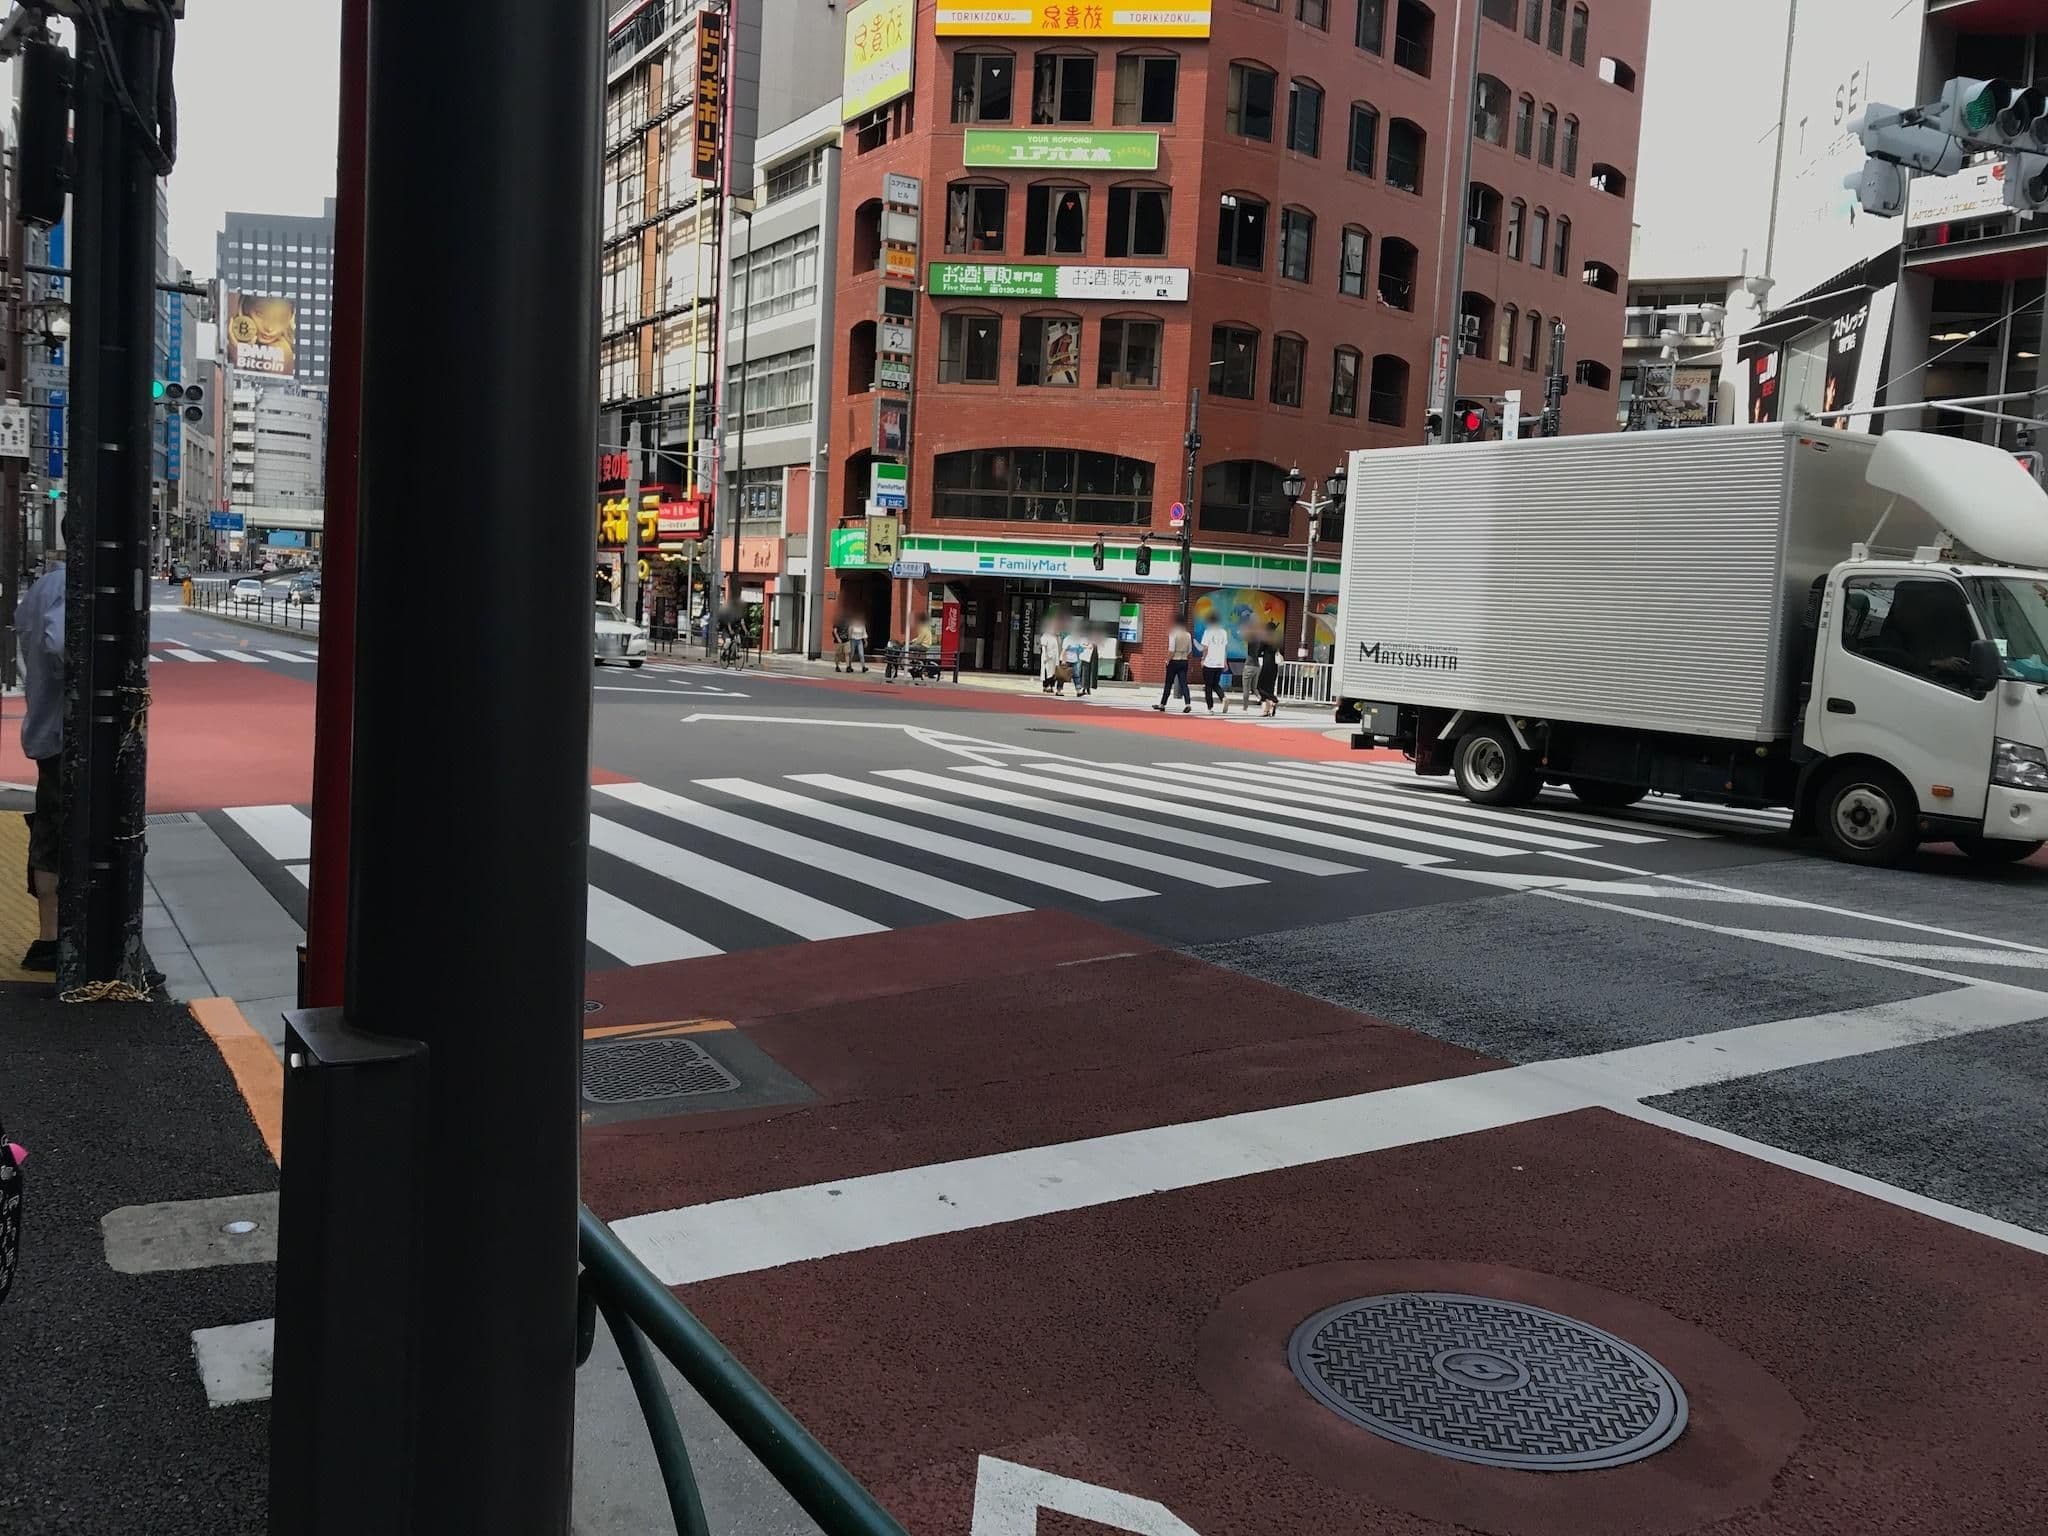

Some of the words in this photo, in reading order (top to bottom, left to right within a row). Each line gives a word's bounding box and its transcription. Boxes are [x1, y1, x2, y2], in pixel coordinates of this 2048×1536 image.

[951, 12, 1010, 21] TORIKIZOKU
[1042, 5, 1102, 29] 鳥貴族
[1130, 13, 1190, 23] TORIKIZOKU
[1027, 135, 1049, 144] YOUR
[1052, 136, 1092, 144] ROPPONGI
[1009, 145, 1112, 162] ユア六本木
[237, 358, 285, 372] Bitcoin
[999, 558, 1067, 572] FamilyMart
[1022, 602, 1034, 669] FamilyMart
[1360, 641, 1458, 670] MATSUSHITA
